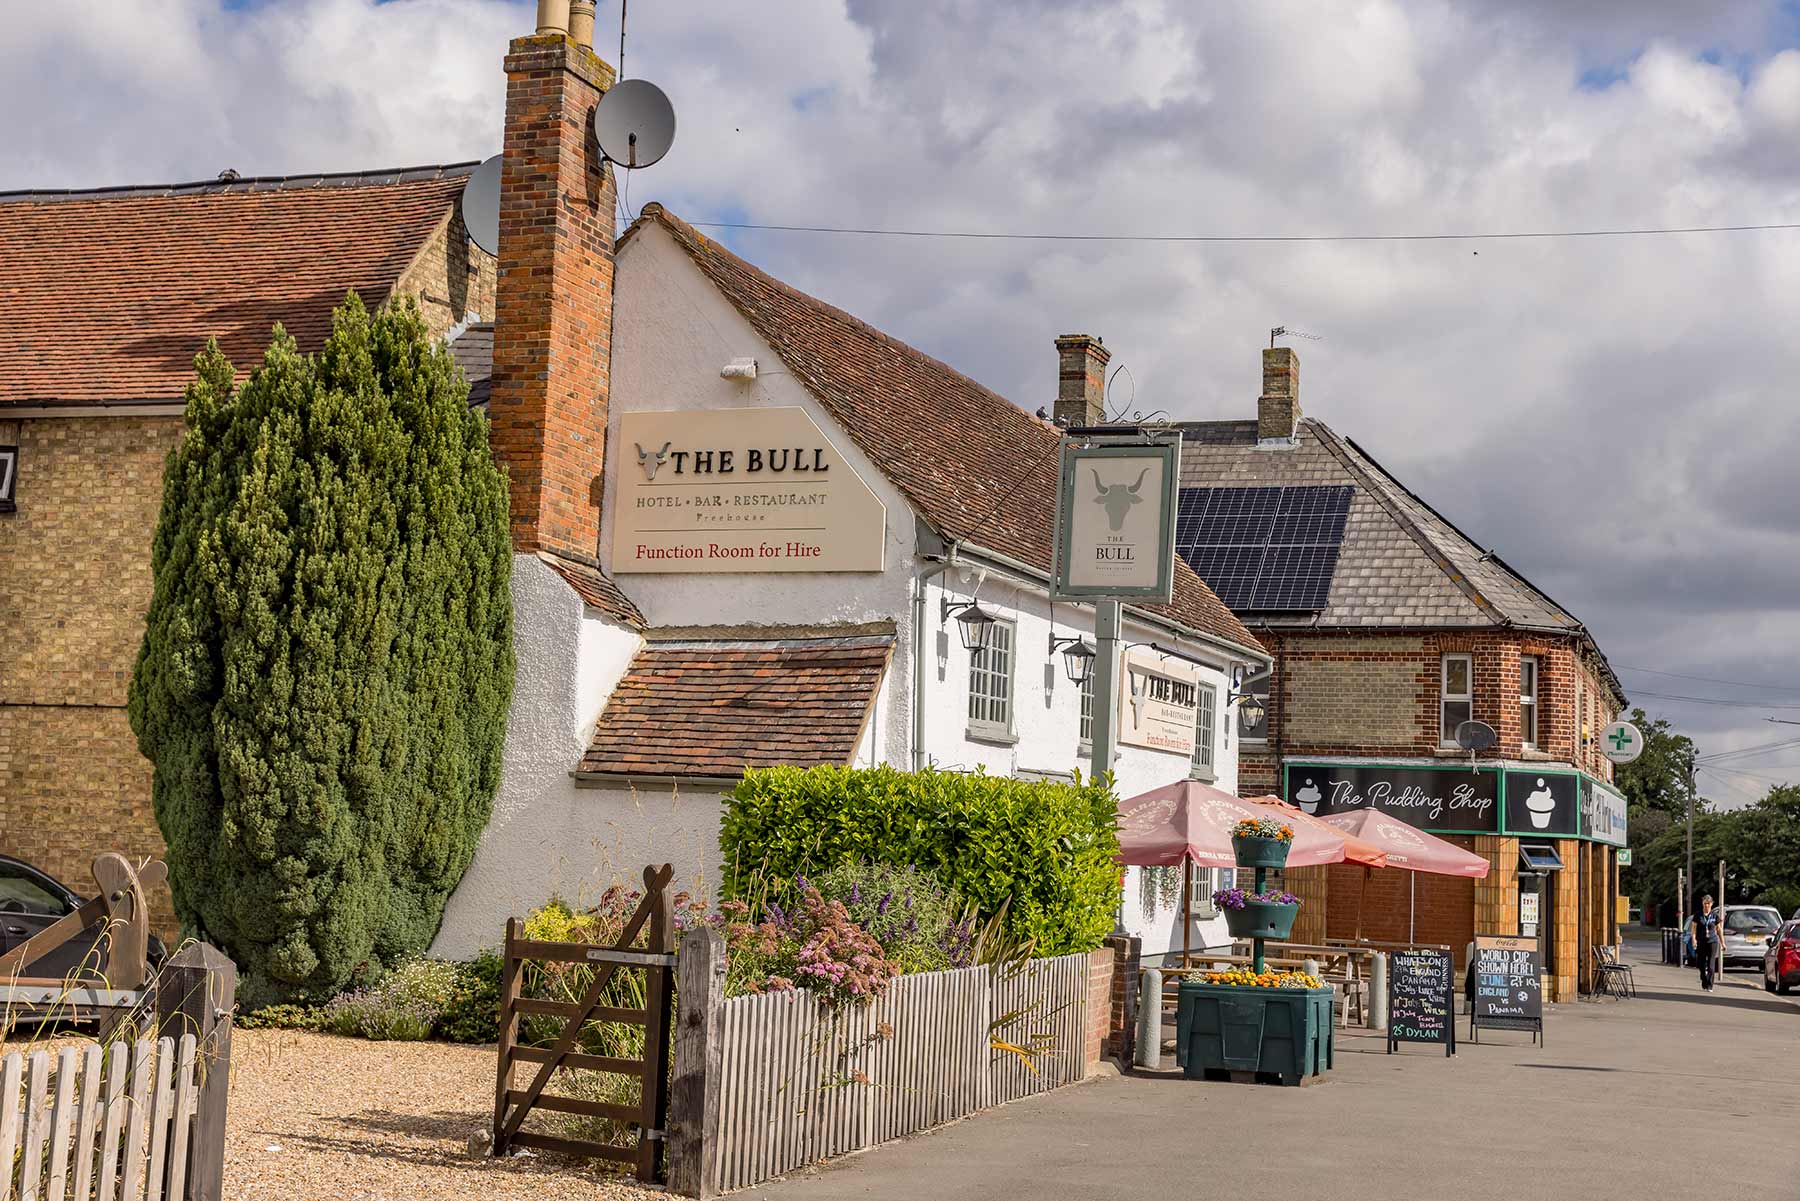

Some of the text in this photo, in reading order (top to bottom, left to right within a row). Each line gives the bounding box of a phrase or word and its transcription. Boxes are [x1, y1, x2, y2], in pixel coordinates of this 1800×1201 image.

[671, 448, 830, 474] THE BULL
[636, 494, 827, 508] HOTEL BAR RESTAURANT
[696, 513, 765, 522] Freehouse
[636, 542, 821, 560] Function Room for Hire
[1096, 548, 1135, 560] BULL
[1149, 674, 1196, 708] THE BULL
[1329, 781, 1492, 820] The Pudding Shop
[1480, 949, 1530, 963] WORLD CUP
[1477, 961, 1509, 974] SHOWN
[1401, 975, 1437, 986] PANAMA
[1480, 974, 1508, 987] JUNE
[1478, 987, 1510, 997] ENGLAND
[1406, 1027, 1440, 1039] DYLAN
